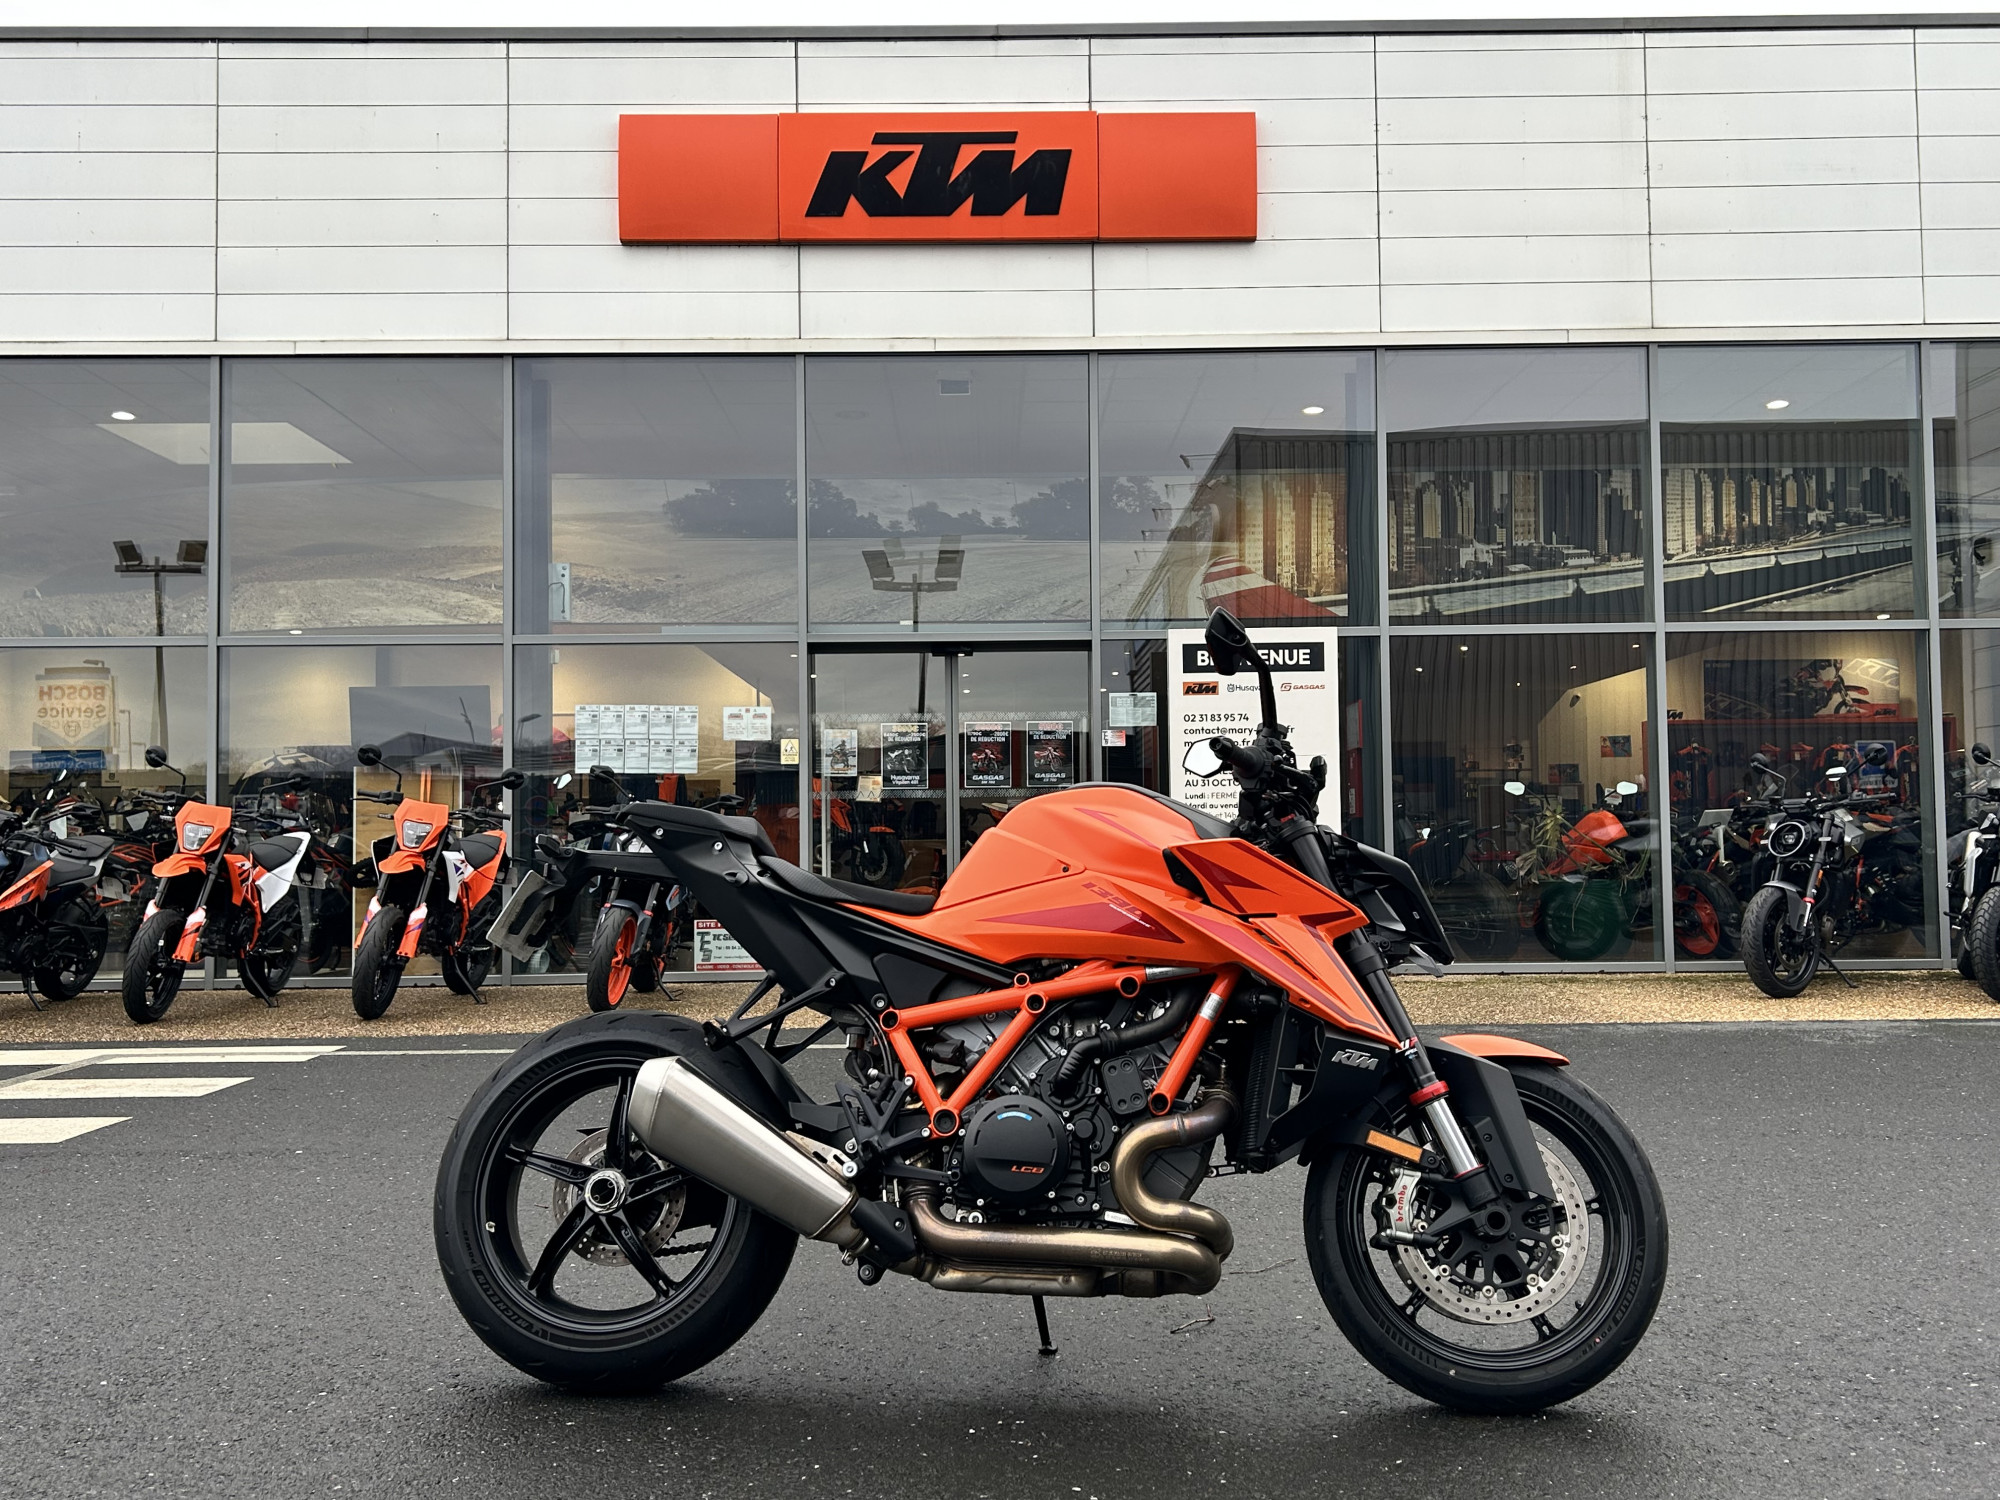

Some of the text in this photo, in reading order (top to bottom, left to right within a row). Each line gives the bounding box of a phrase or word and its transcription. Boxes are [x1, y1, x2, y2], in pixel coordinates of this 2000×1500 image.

[805, 130, 1072, 218] KTM
[1197, 649, 1311, 667] BENUE
[1184, 682, 1218, 694] KTM
[1183, 713, 1249, 723] 02 31 83 95 74
[1667, 709, 1683, 719] TM
[1183, 725, 1295, 736] contact@mary-fr
[1184, 779, 1241, 787] AU 31 OCTO
[1184, 792, 1206, 800] Lundi
[1211, 790, 1238, 800] FERMÉ
[1331, 1048, 1379, 1071] KTM
[1395, 1184, 1408, 1222] brembo
[1614, 1255, 1645, 1322] MICHELIN
[474, 1270, 532, 1330] MICHELIN
